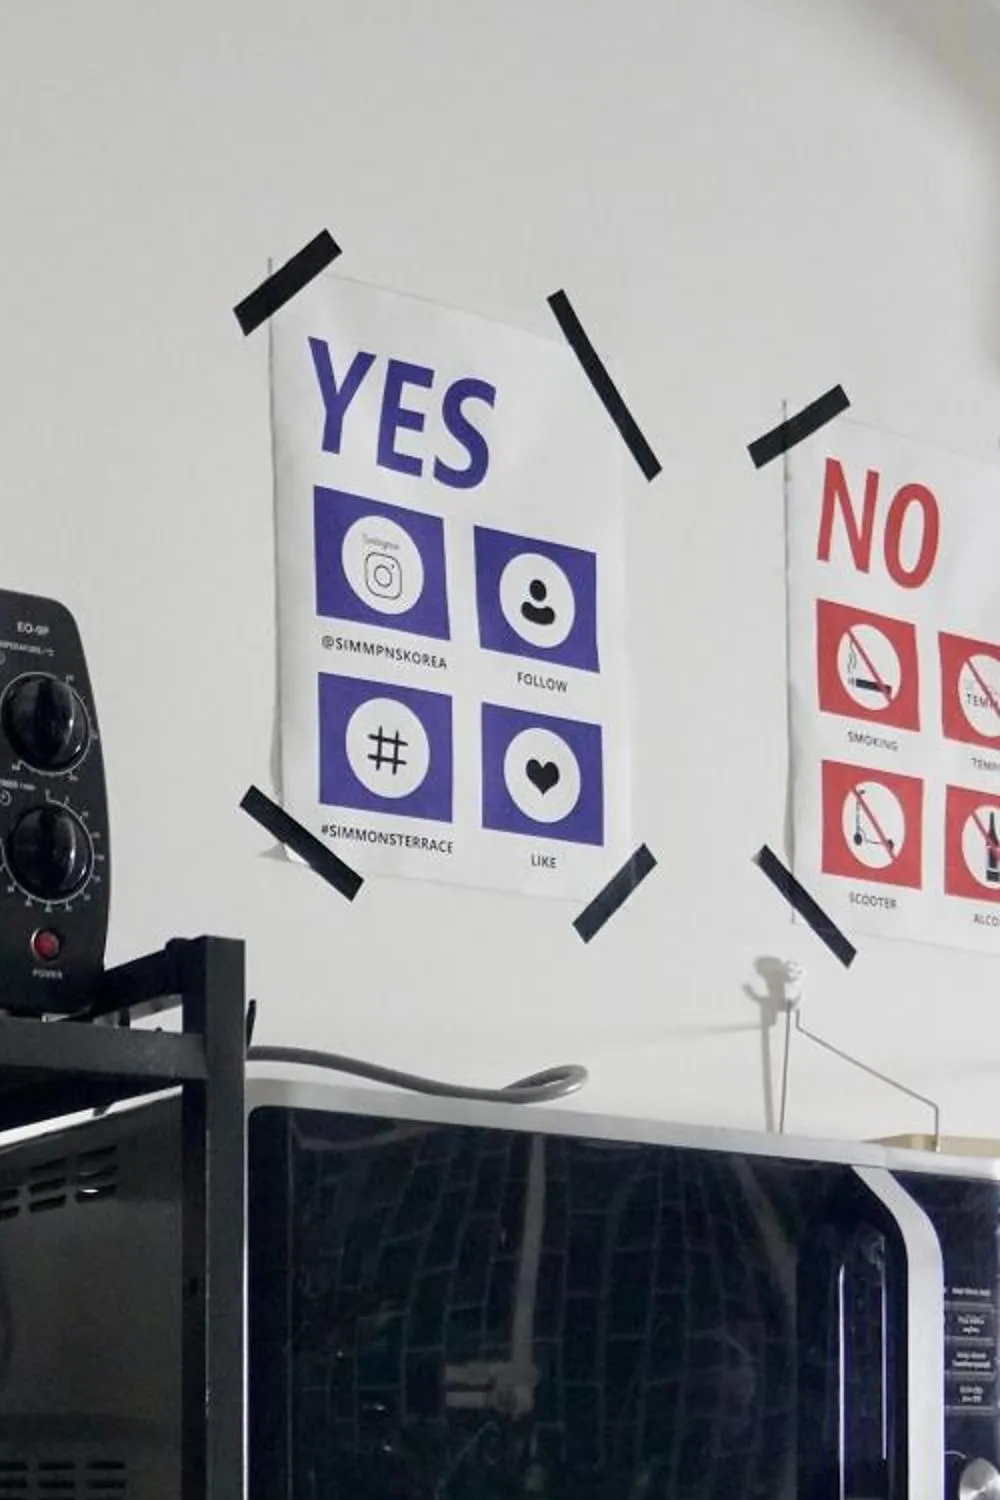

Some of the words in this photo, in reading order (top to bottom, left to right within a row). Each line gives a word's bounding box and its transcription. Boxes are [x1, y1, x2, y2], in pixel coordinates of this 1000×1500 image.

[307, 336, 497, 490] YES
[817, 457, 940, 589] NO
[517, 671, 568, 693] FOLLOW
[847, 731, 898, 752] SMOKING
[321, 824, 454, 855] #SIMMONSTERRACE
[530, 853, 557, 869] LIKE
[848, 890, 897, 909] SCOOTER
